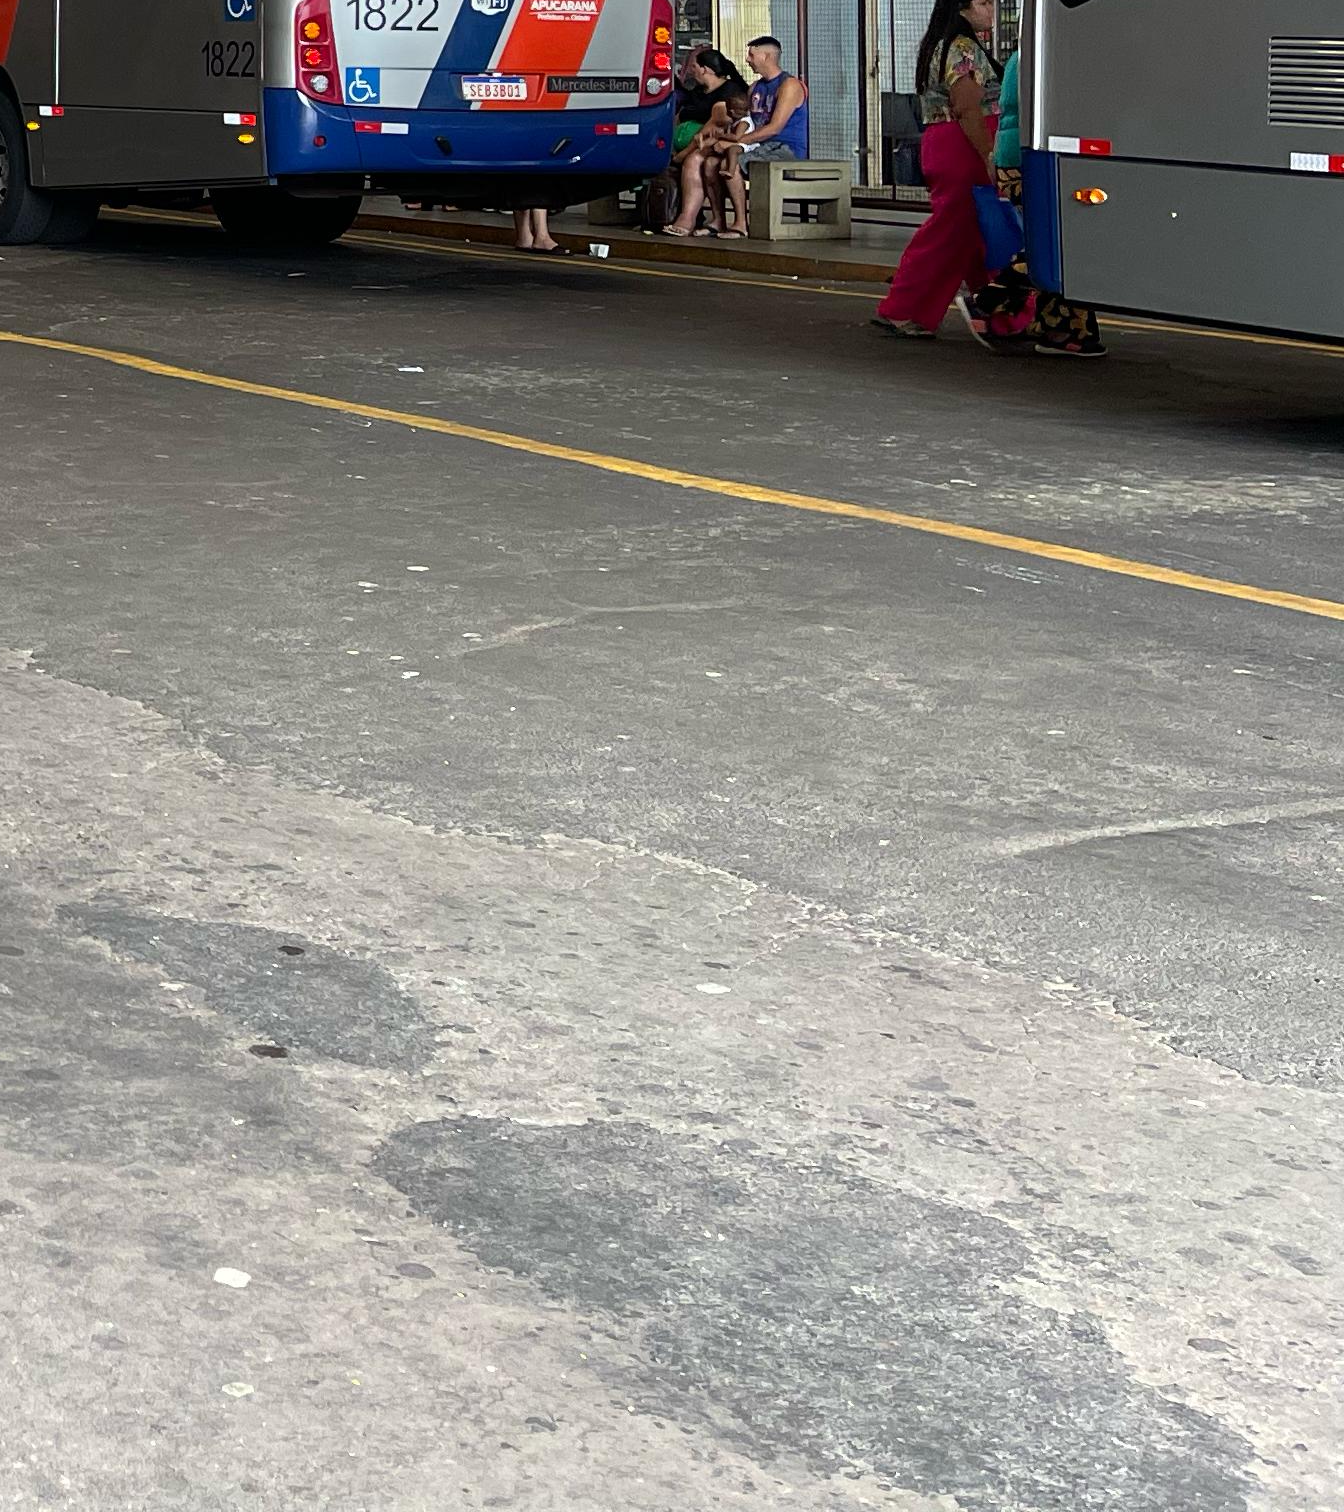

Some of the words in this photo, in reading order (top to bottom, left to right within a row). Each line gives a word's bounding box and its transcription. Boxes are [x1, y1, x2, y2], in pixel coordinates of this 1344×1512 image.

[530, 0, 597, 12] APUCARANA
[202, 40, 255, 78] 1822
[551, 78, 636, 92] Mercedes-Benz
